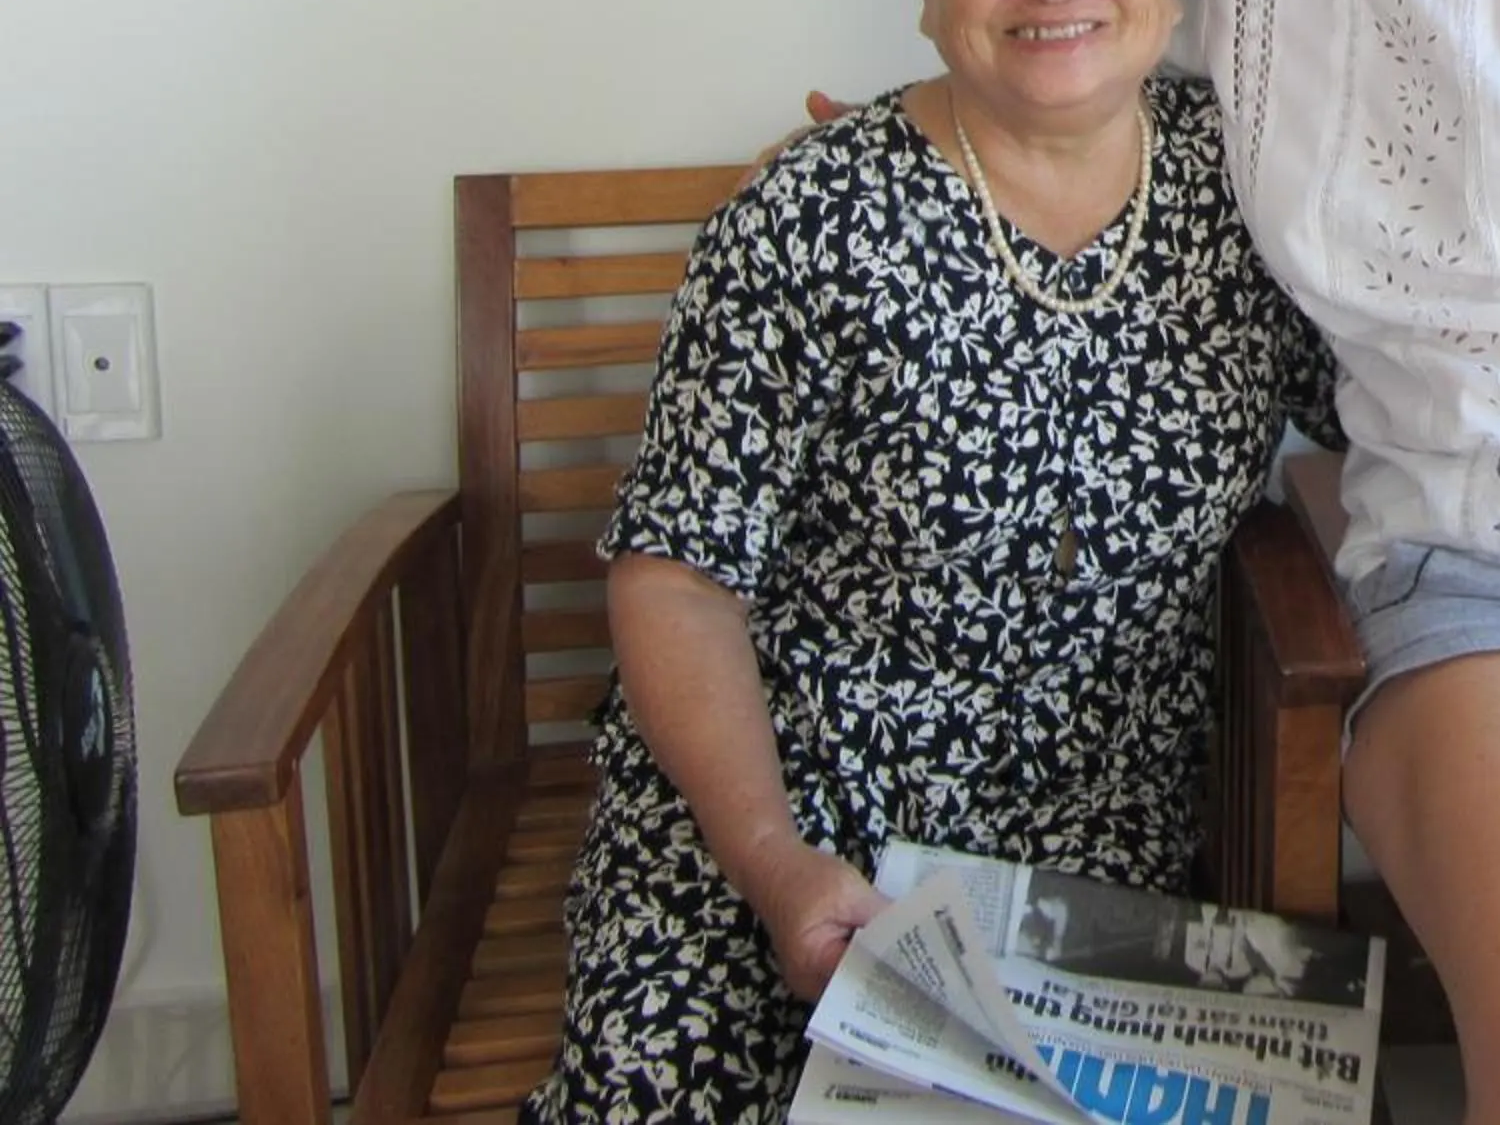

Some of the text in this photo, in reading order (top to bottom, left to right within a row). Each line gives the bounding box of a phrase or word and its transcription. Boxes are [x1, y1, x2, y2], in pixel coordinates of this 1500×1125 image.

[1041, 980, 1085, 1007] Lai
[1093, 996, 1139, 1017] Gia
[1069, 1003, 1165, 1043] hung
[1174, 1025, 1292, 1060] nhanh
[1299, 1043, 1361, 1084] Bắt
